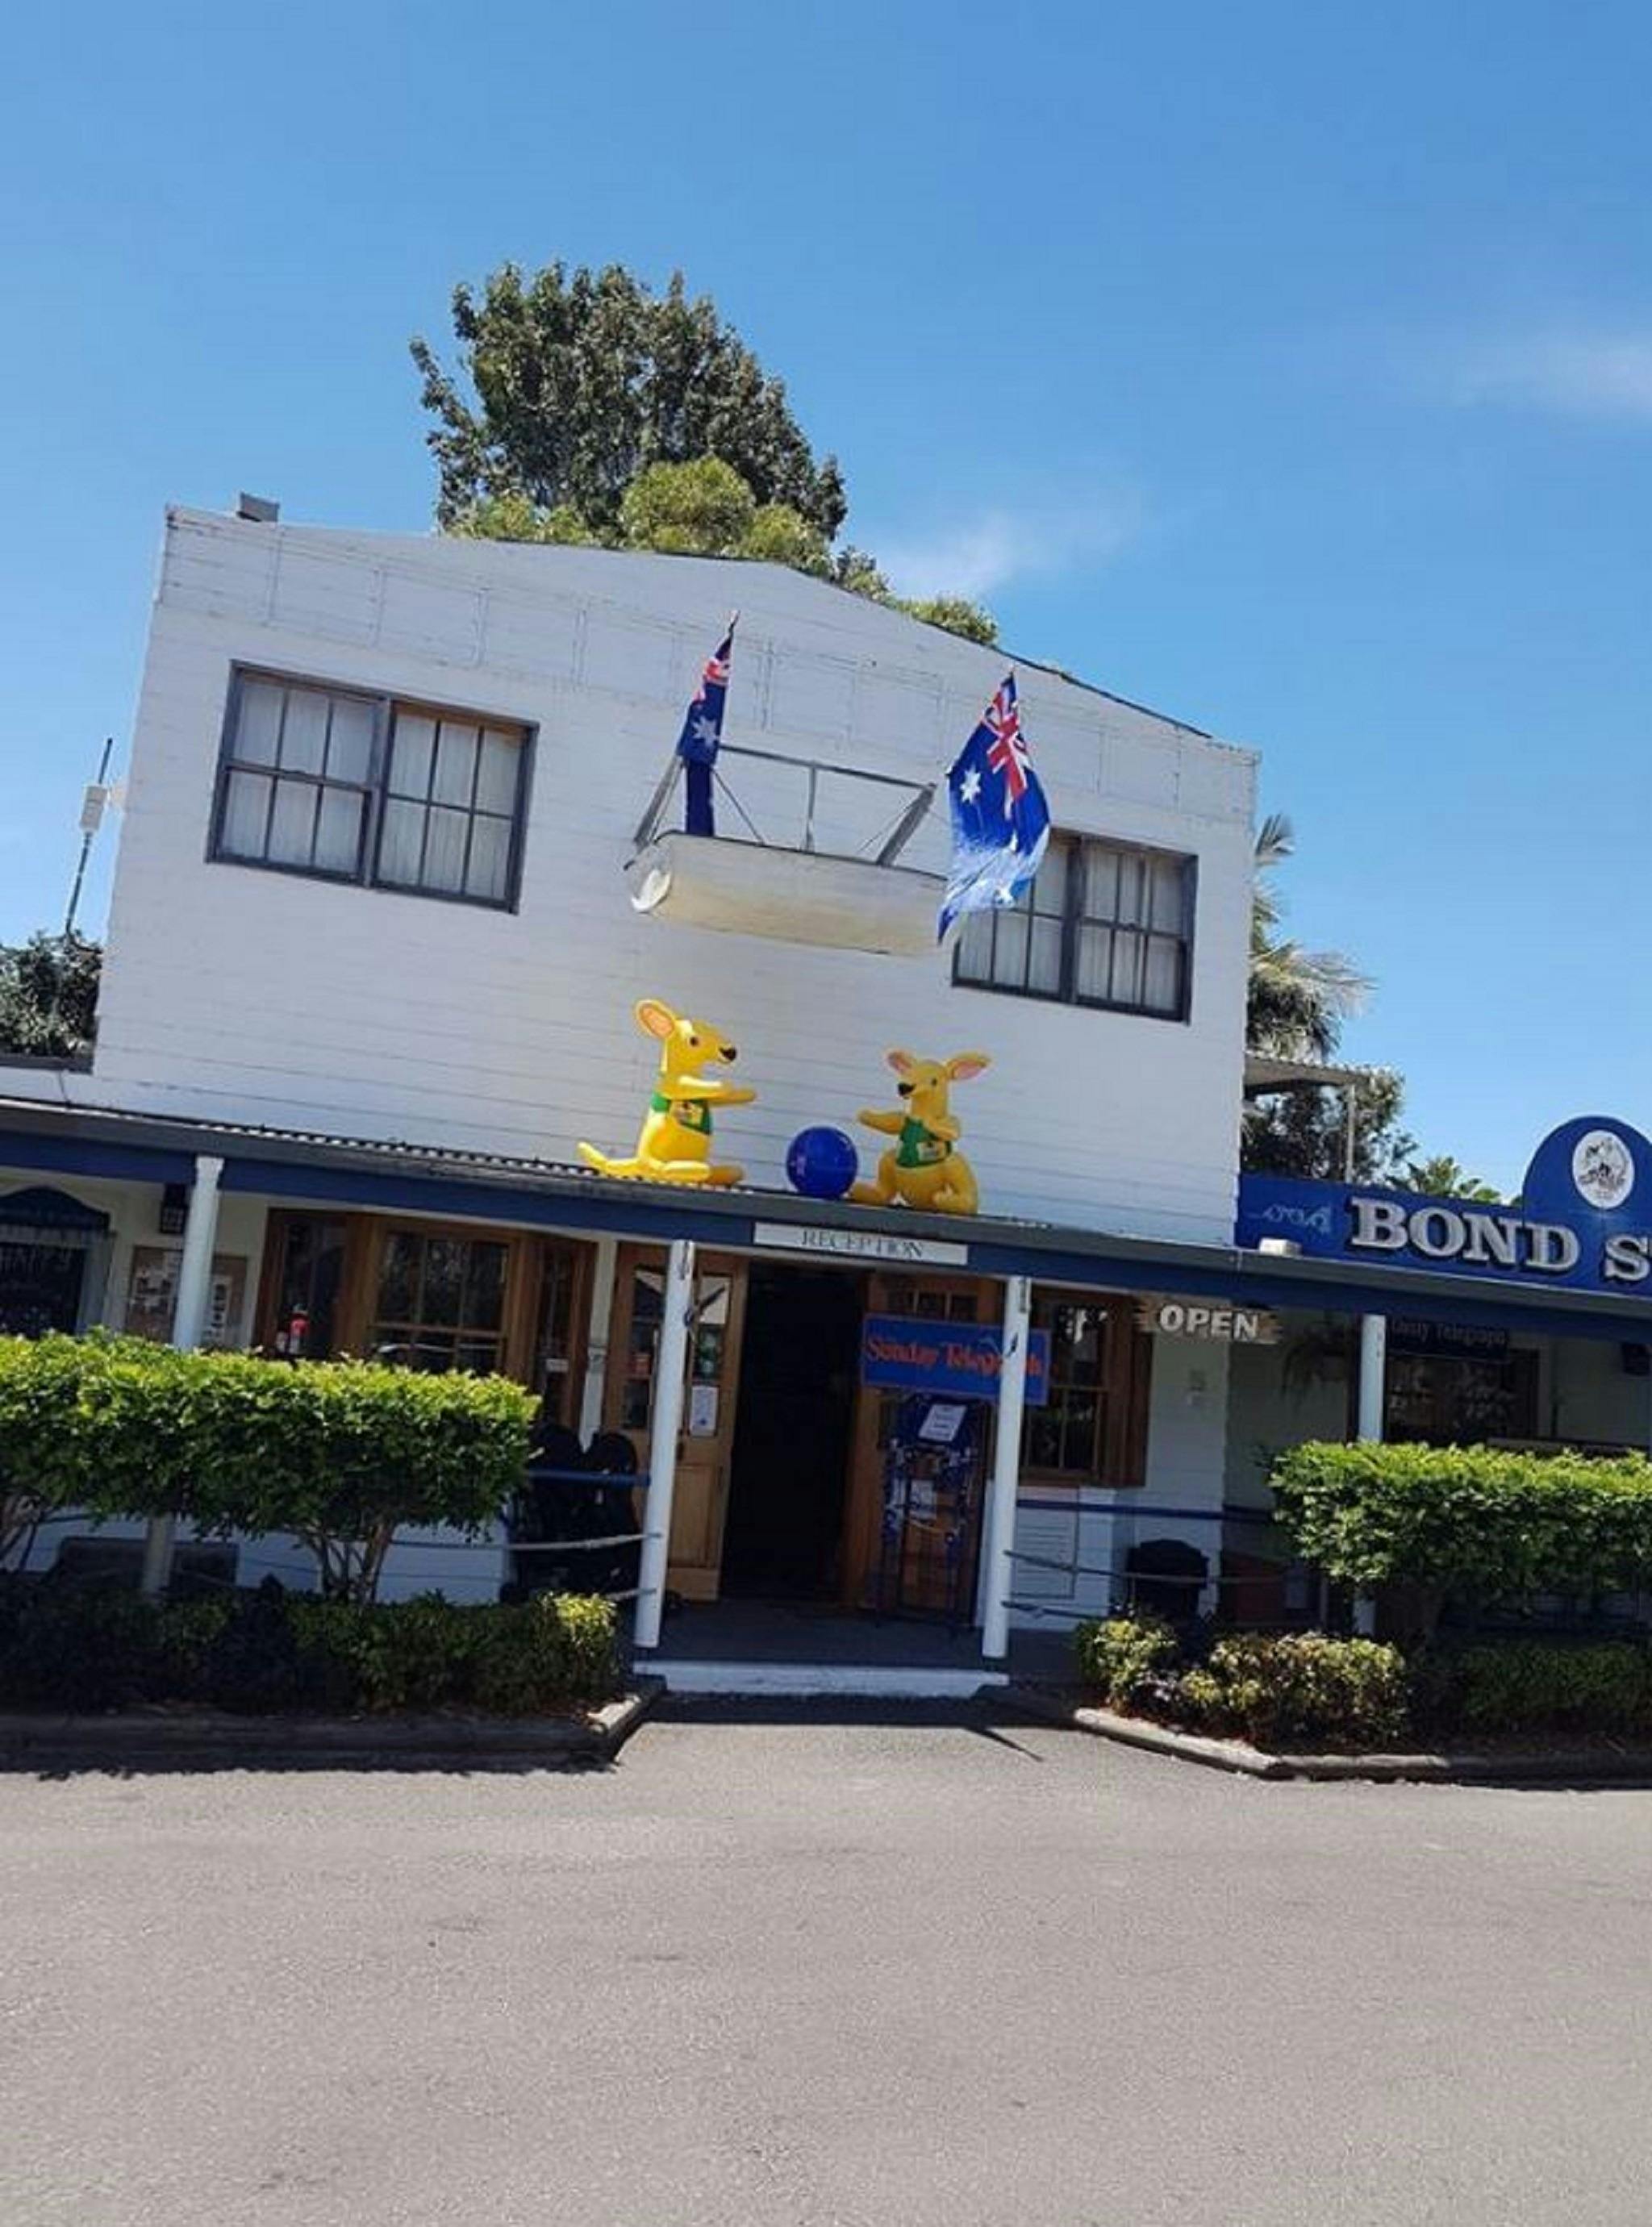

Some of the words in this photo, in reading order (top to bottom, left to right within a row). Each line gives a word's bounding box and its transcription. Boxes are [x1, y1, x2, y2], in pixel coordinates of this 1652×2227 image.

[801, 1230, 924, 1260] RECEPTION
[1350, 1197, 1582, 1273] BOND
[1604, 1234, 1652, 1282] S
[1159, 1303, 1259, 1343] OPEN
[866, 1337, 939, 1367] Sunday
